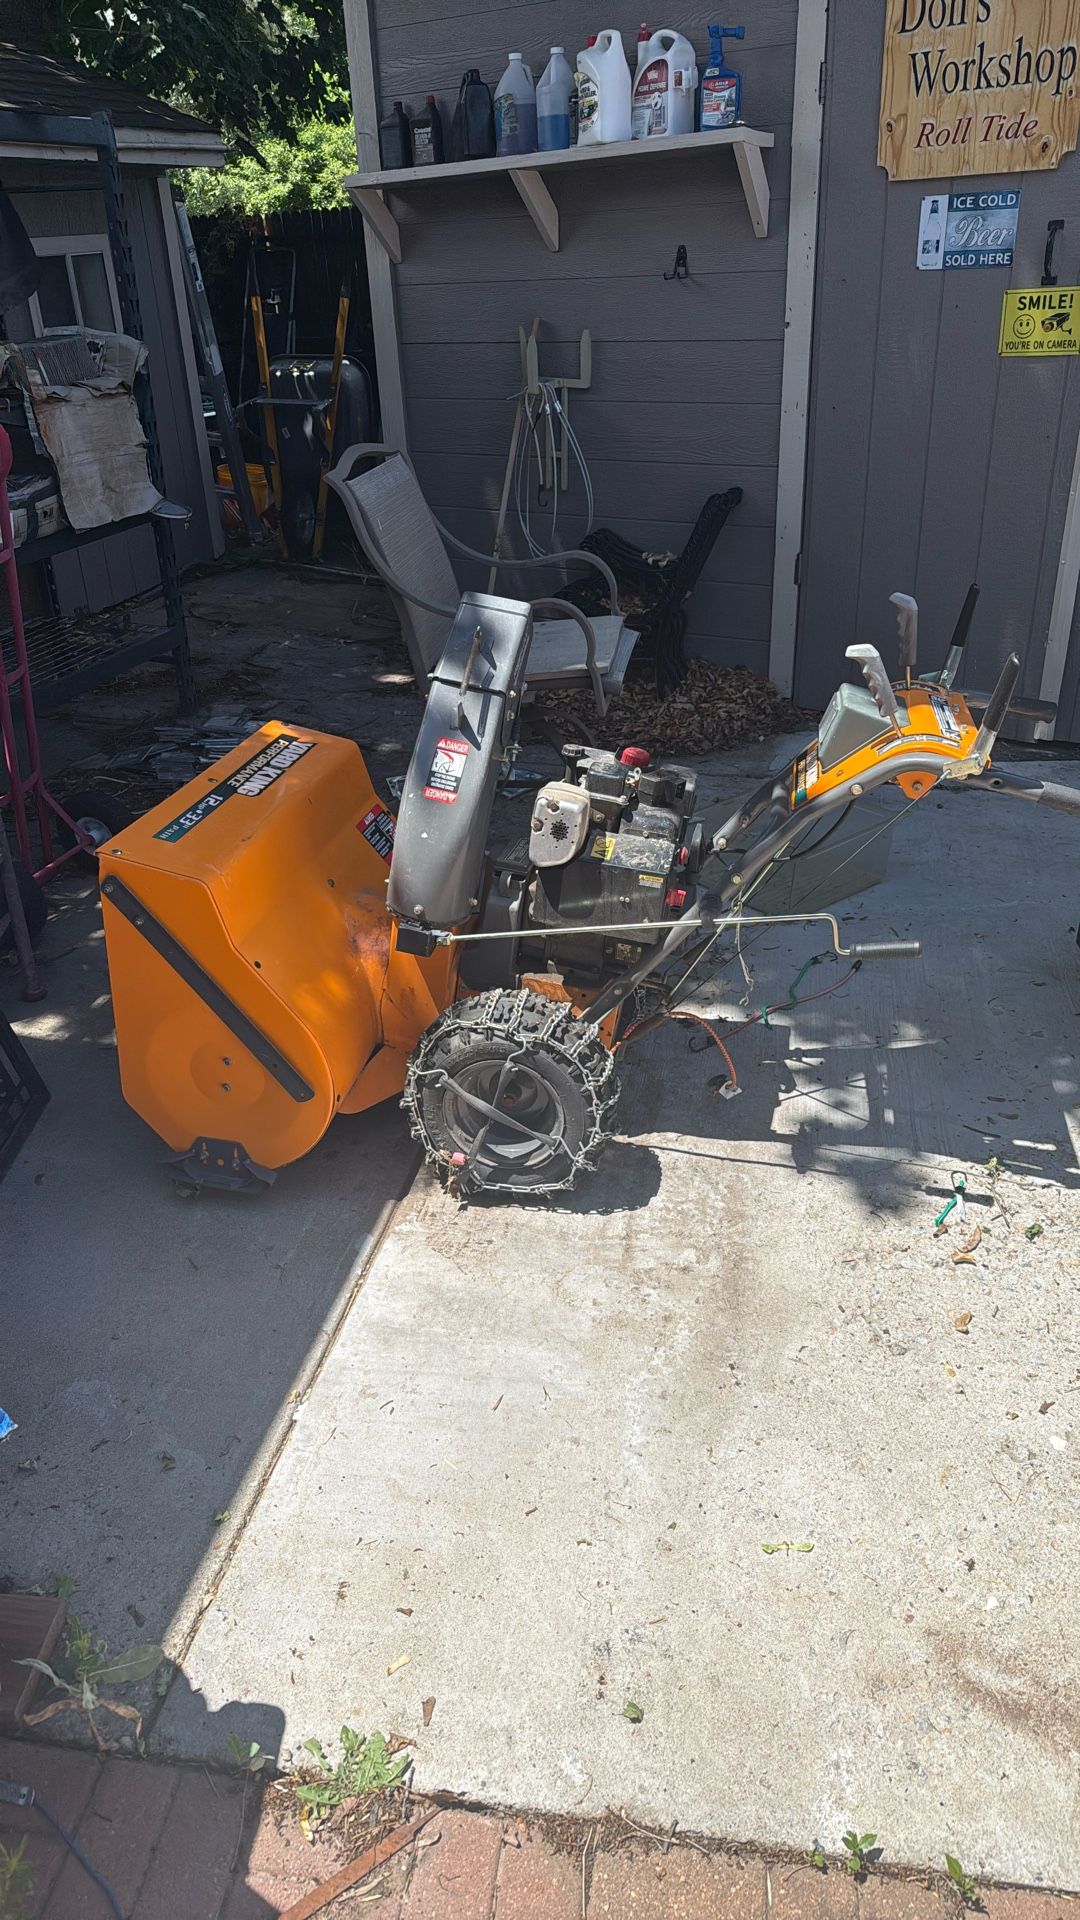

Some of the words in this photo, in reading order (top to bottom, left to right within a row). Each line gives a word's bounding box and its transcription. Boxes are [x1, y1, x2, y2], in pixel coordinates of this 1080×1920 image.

[897, 0, 991, 34] Dons
[908, 36, 1078, 98] Workshop
[914, 116, 973, 149] Roll
[979, 112, 1039, 143] Tide
[953, 196, 975, 209] ICE
[979, 193, 1017, 207] COLD
[949, 214, 1015, 248] Beer
[945, 254, 976, 266] SOLD
[980, 252, 1012, 265] HERE
[1017, 293, 1074, 311] SMILE!
[1005, 341, 1031, 350] YOU'RE
[1033, 340, 1045, 350] ON
[1047, 339, 1077, 350] CAMERA
[269, 740, 314, 768] YARD
[446, 740, 469, 752] DANGER
[227, 738, 289, 788] PERFORMANCE
[236, 768, 285, 796] KING
[159, 824, 180, 839] PATH
